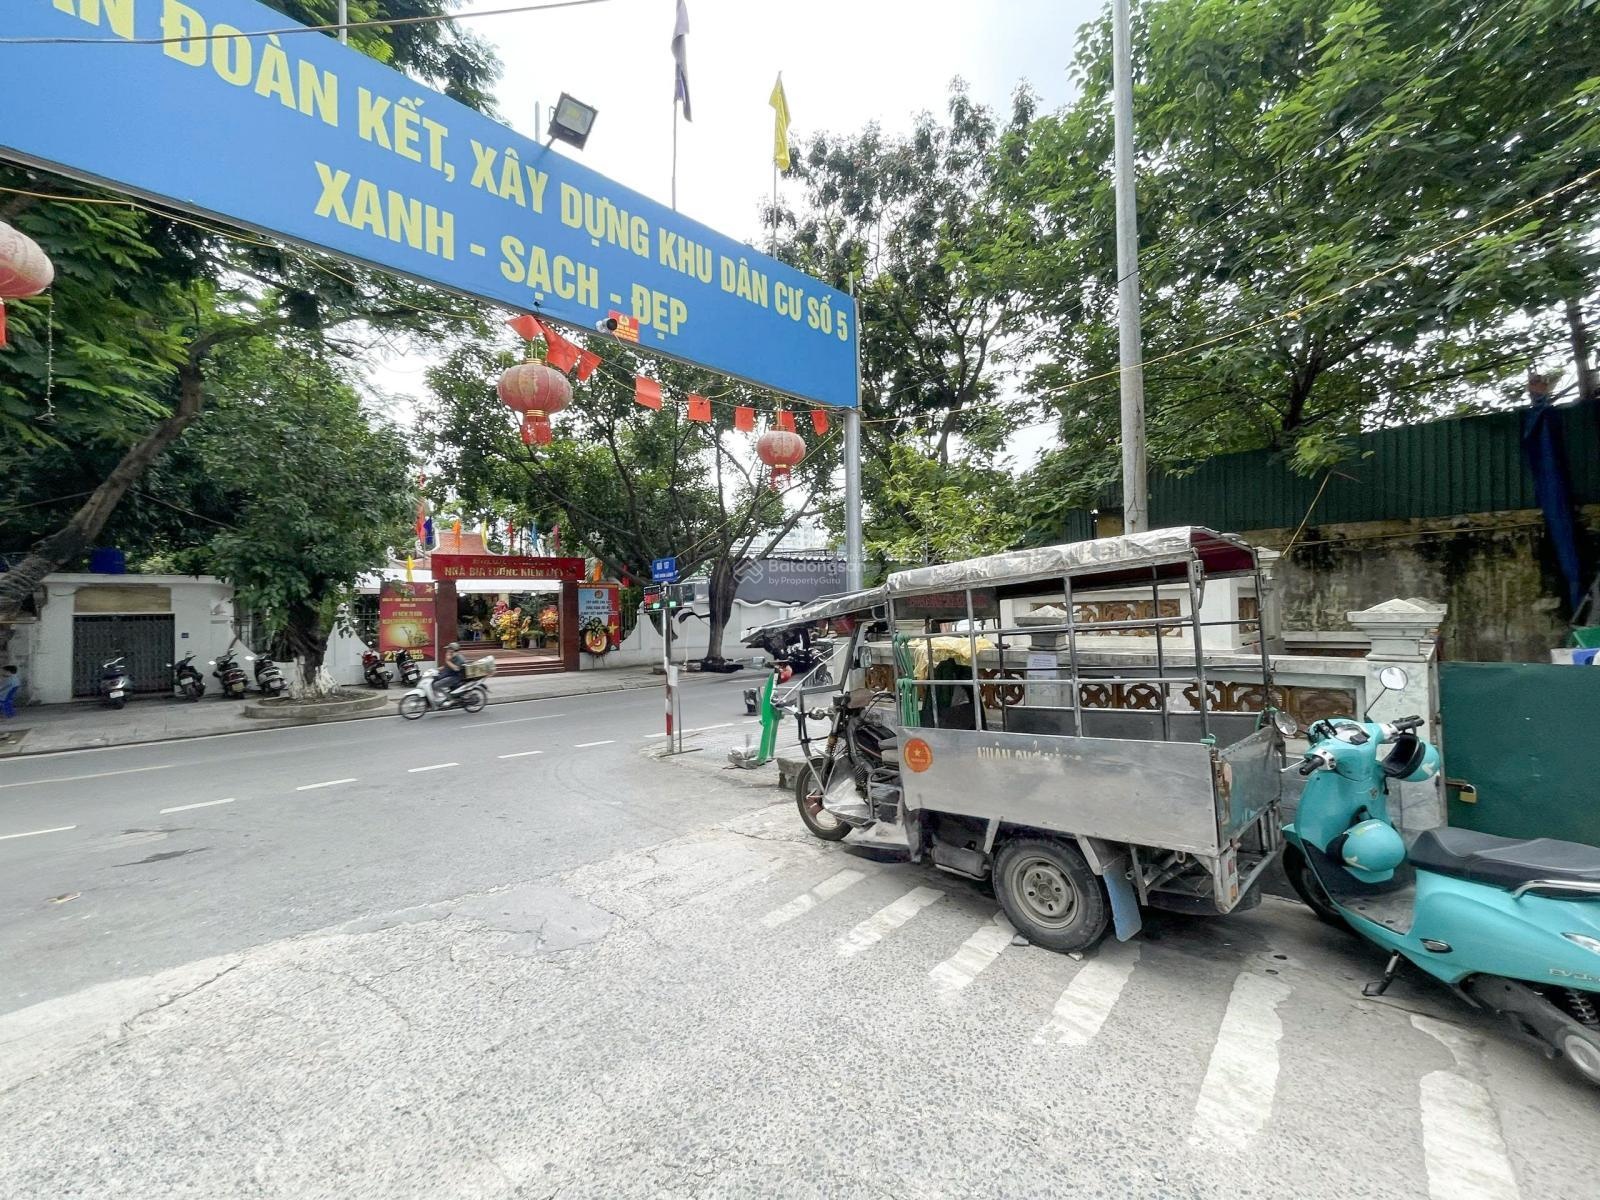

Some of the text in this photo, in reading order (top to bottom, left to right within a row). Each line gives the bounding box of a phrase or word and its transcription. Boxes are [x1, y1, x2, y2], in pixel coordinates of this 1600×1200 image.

[160, 0, 338, 127] ĐOÀN
[358, 86, 456, 182] KẾT,
[470, 138, 549, 214] XÂY
[560, 182, 649, 258] DỰNG
[659, 227, 713, 284] KHU
[720, 256, 768, 309] DÂN
[774, 281, 804, 322] CƯ
[807, 294, 833, 335] SỐ
[837, 310, 848, 342] 5
[314, 161, 455, 261] XANH
[500, 235, 599, 311] SẠCH
[631, 283, 688, 340] ĐẸP
